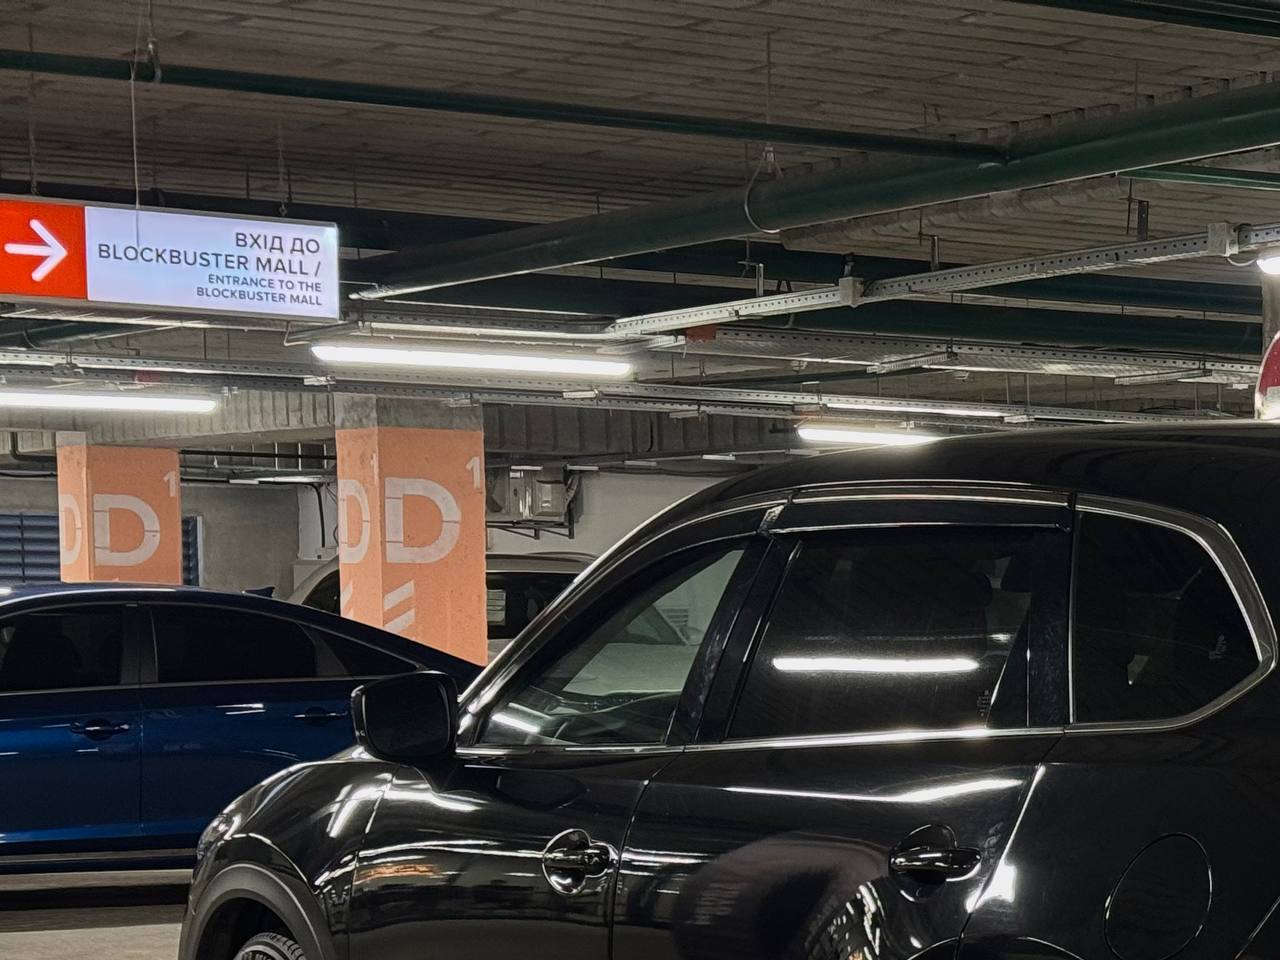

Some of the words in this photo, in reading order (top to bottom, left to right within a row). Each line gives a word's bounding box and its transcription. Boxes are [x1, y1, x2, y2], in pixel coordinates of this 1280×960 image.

[235, 232, 284, 253] ВХІД
[290, 238, 320, 255] ДО
[98, 243, 249, 271] BLOCKBUSTER
[255, 257, 308, 276] MALL
[197, 286, 286, 304] BLOCKBUSTER
[290, 294, 322, 306] MALL
[208, 273, 275, 290] ENTRANCE
[278, 278, 296, 290] TO
[297, 280, 322, 292] THE
[93, 493, 160, 567] D
[385, 477, 462, 564] D
